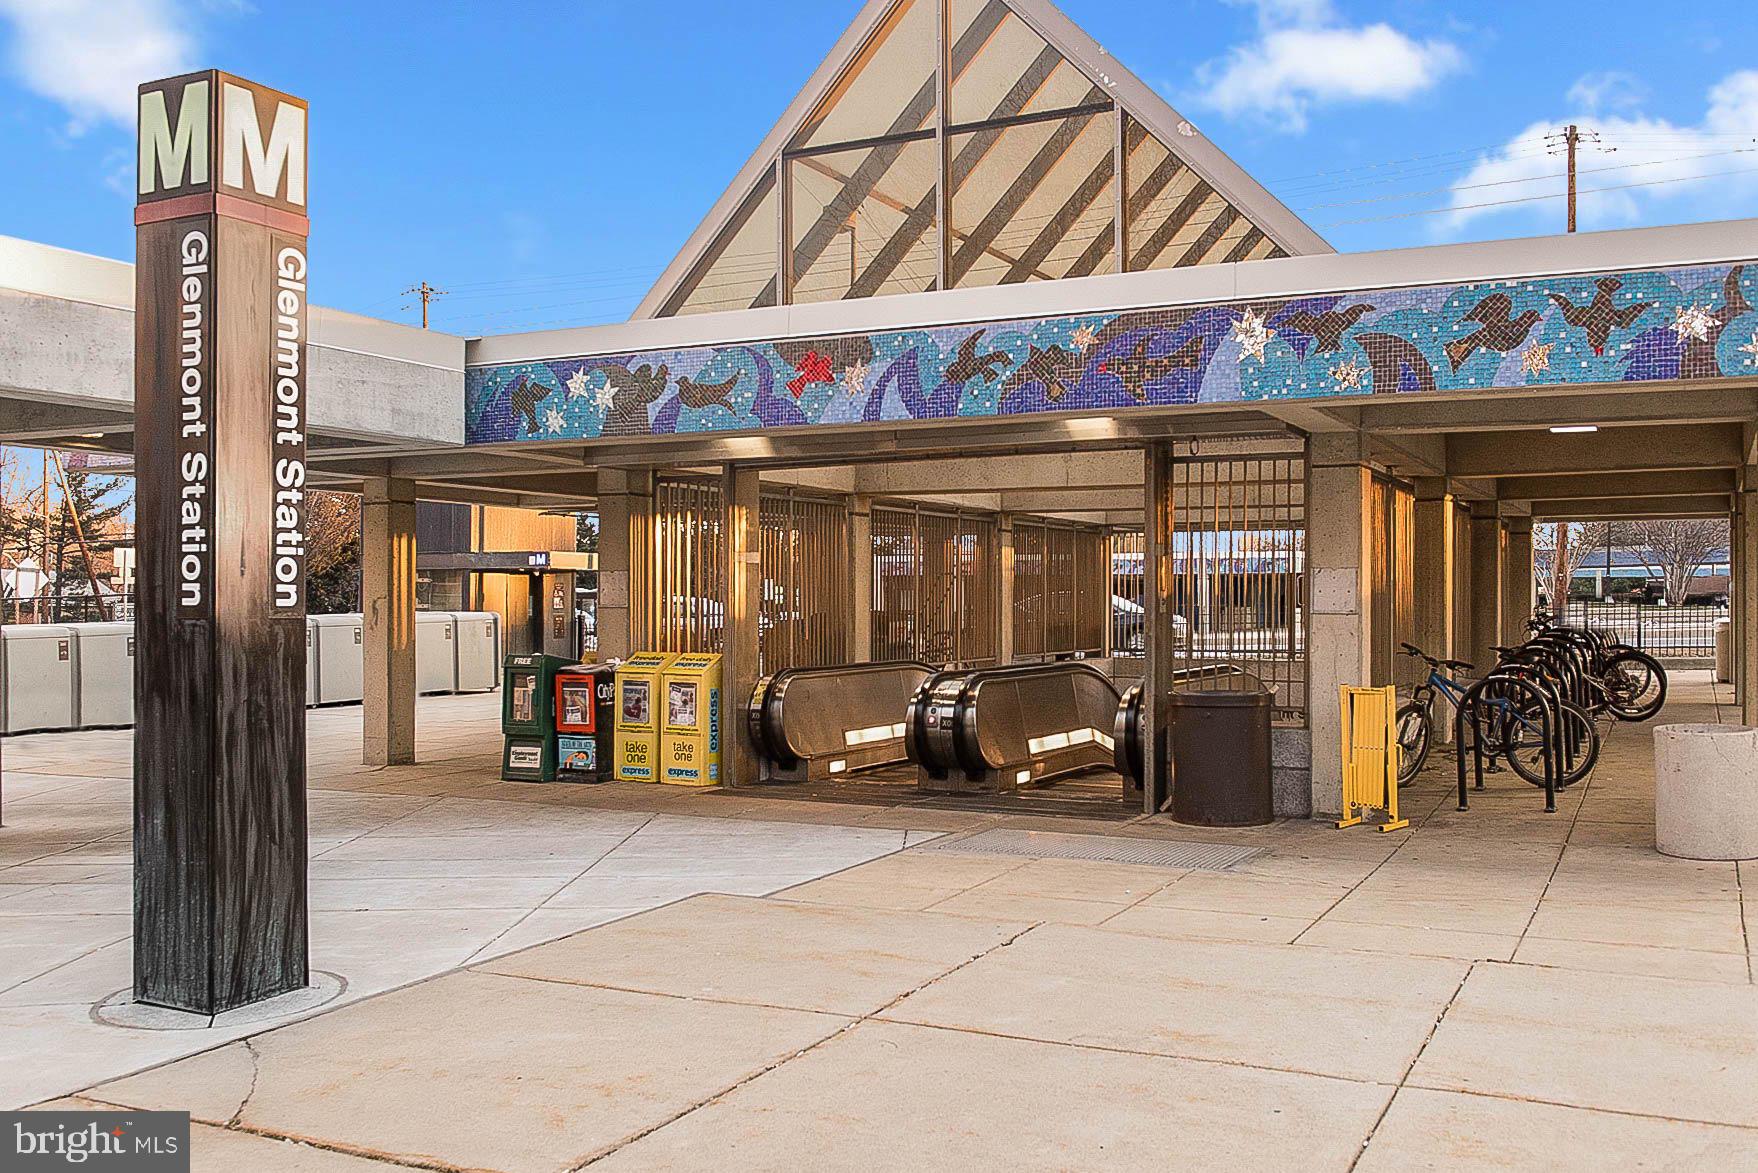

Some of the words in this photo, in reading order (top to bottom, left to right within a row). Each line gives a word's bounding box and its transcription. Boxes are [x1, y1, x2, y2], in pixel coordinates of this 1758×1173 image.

[139, 80, 208, 195] M
[222, 81, 305, 206] M
[181, 230, 208, 438] Glenmont
[275, 246, 307, 447] Glenmont
[181, 451, 208, 607] Station
[274, 459, 305, 609] Station
[513, 657, 532, 665] FREE
[597, 682, 614, 700] CityP
[710, 690, 719, 751] express
[625, 741, 648, 754] take
[673, 741, 694, 753] take
[626, 753, 647, 763] one
[673, 752, 693, 762] one
[622, 767, 650, 775] express
[668, 768, 698, 777] express
